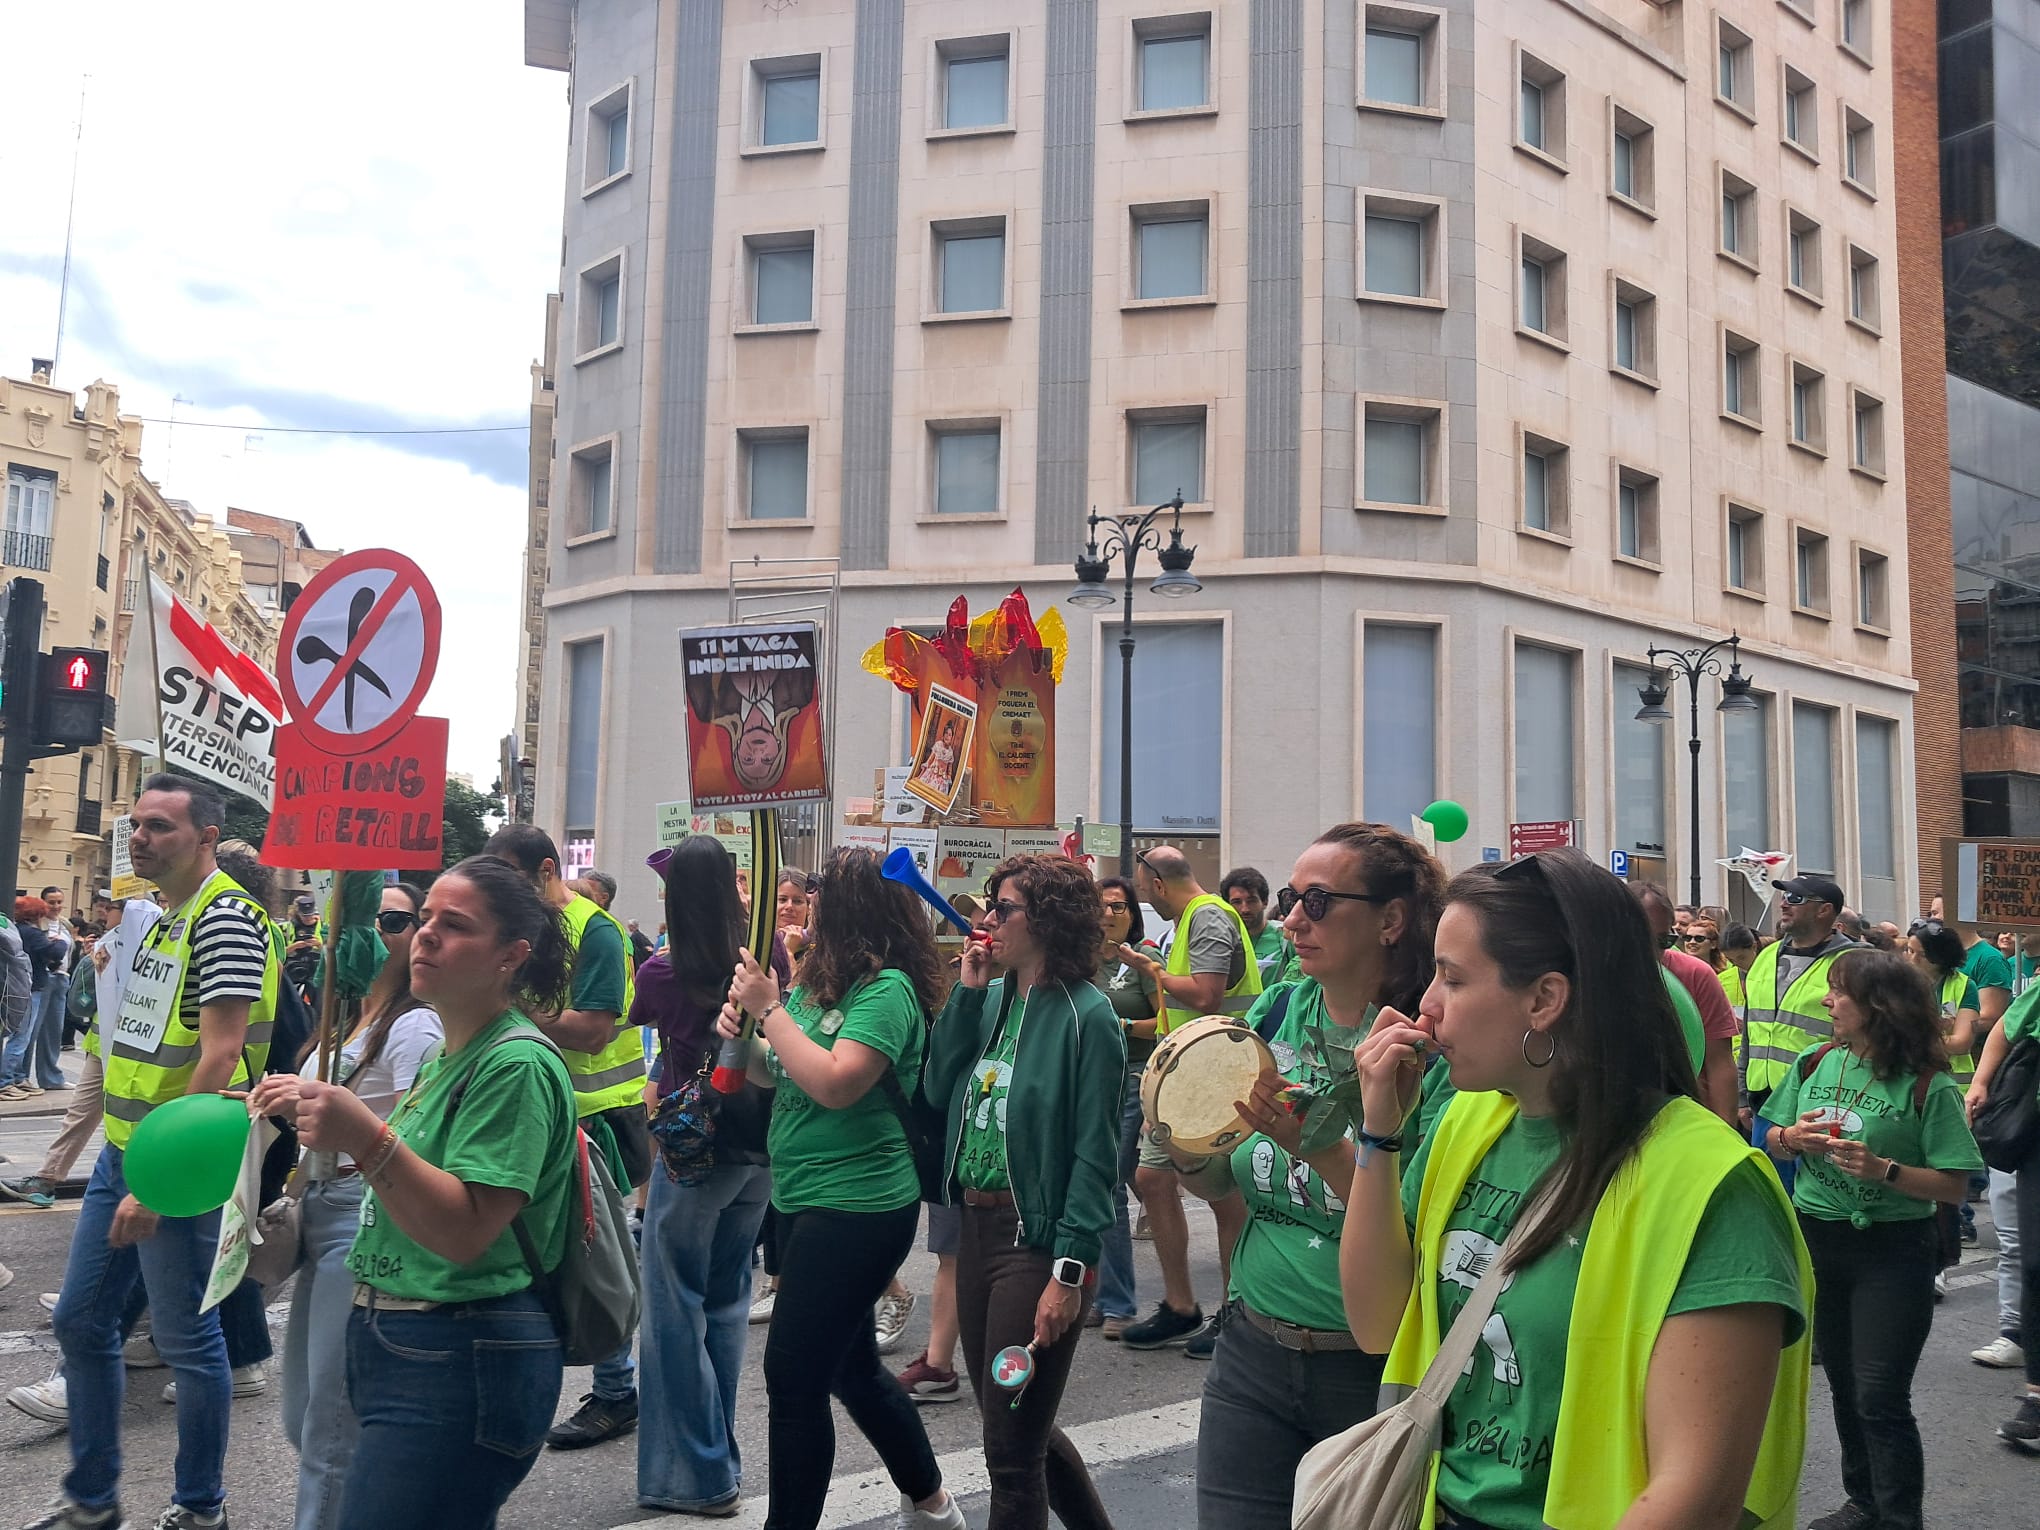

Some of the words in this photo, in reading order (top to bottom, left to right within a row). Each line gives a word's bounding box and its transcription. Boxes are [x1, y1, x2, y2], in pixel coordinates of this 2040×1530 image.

[699, 639, 718, 655] 11
[721, 638, 739, 653] M
[742, 635, 800, 652] VAGA
[688, 653, 812, 675] INDEFINIDA
[163, 734, 270, 801] VALENCIANA
[283, 756, 426, 800] CAMPIONS
[696, 796, 729, 806] TOTES
[736, 793, 763, 802] TOTS
[765, 791, 779, 799] AL
[315, 804, 439, 851] RETALL
[664, 818, 687, 828] MESTRA
[943, 838, 992, 848] BUROCRÀCIA
[1036, 839, 1060, 847] CREMATS
[948, 850, 1001, 859] BURROCRÀCIA
[1983, 849, 2008, 862] PER
[1614, 852, 1625, 873] P
[1983, 876, 2030, 890] PRIMER
[1983, 890, 2025, 904] DONAR
[1808, 1085, 1895, 1119] ESTIMEM
